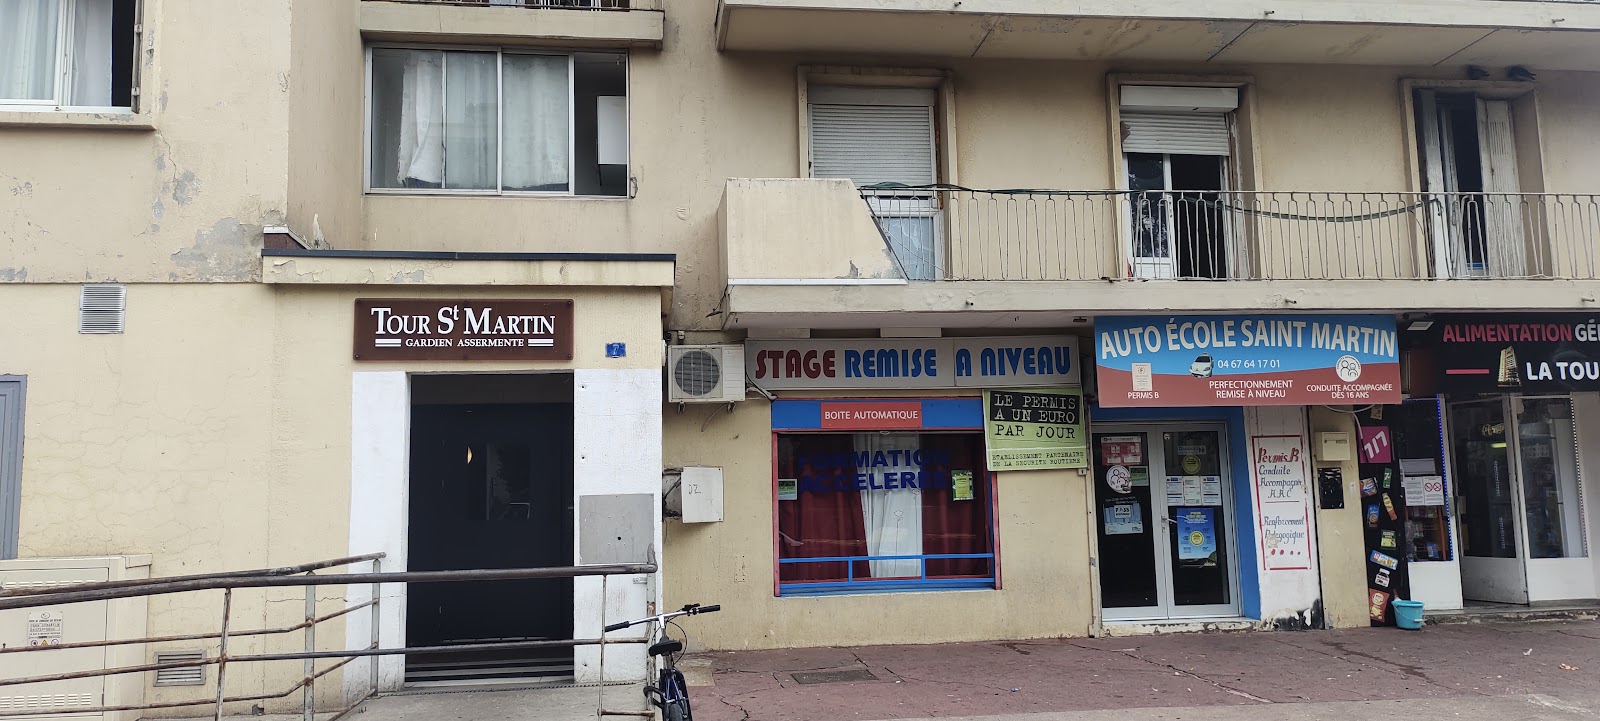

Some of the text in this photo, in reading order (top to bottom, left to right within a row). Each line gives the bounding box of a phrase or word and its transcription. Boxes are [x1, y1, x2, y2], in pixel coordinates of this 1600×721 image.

[371, 305, 556, 335] TOUR St MARTIN
[1101, 317, 1396, 360] AUTO ÉCOLE SAINT MARTIN
[1442, 318, 1600, 343] ALIMENTATION GÉ
[405, 338, 525, 347] GARDIEN ASSERMENTE
[755, 346, 1070, 379] STAGE REMISE A NIVEAU
[1217, 359, 1280, 369] 04 67 64 17 01
[1526, 361, 1553, 381] LA
[1209, 380, 1294, 389] PERFECTIONNEMENT
[1306, 383, 1393, 392] CONDUITE ACCOMPAGNÉE
[994, 393, 1076, 410] LE PERMIS
[1127, 391, 1160, 399] PERMIS B
[1216, 388, 1286, 399] REMISE À NIVEAU
[1346, 391, 1355, 399] 16
[1355, 391, 1370, 399] ANS
[824, 410, 919, 421] BOITE AUTOMATIQUE
[994, 408, 1075, 424] A UN EURO
[994, 423, 1076, 439] PAR JOUR
[798, 448, 949, 468] FORMATION
[1257, 447, 1300, 464] Permis B
[1258, 464, 1291, 476] Conduite
